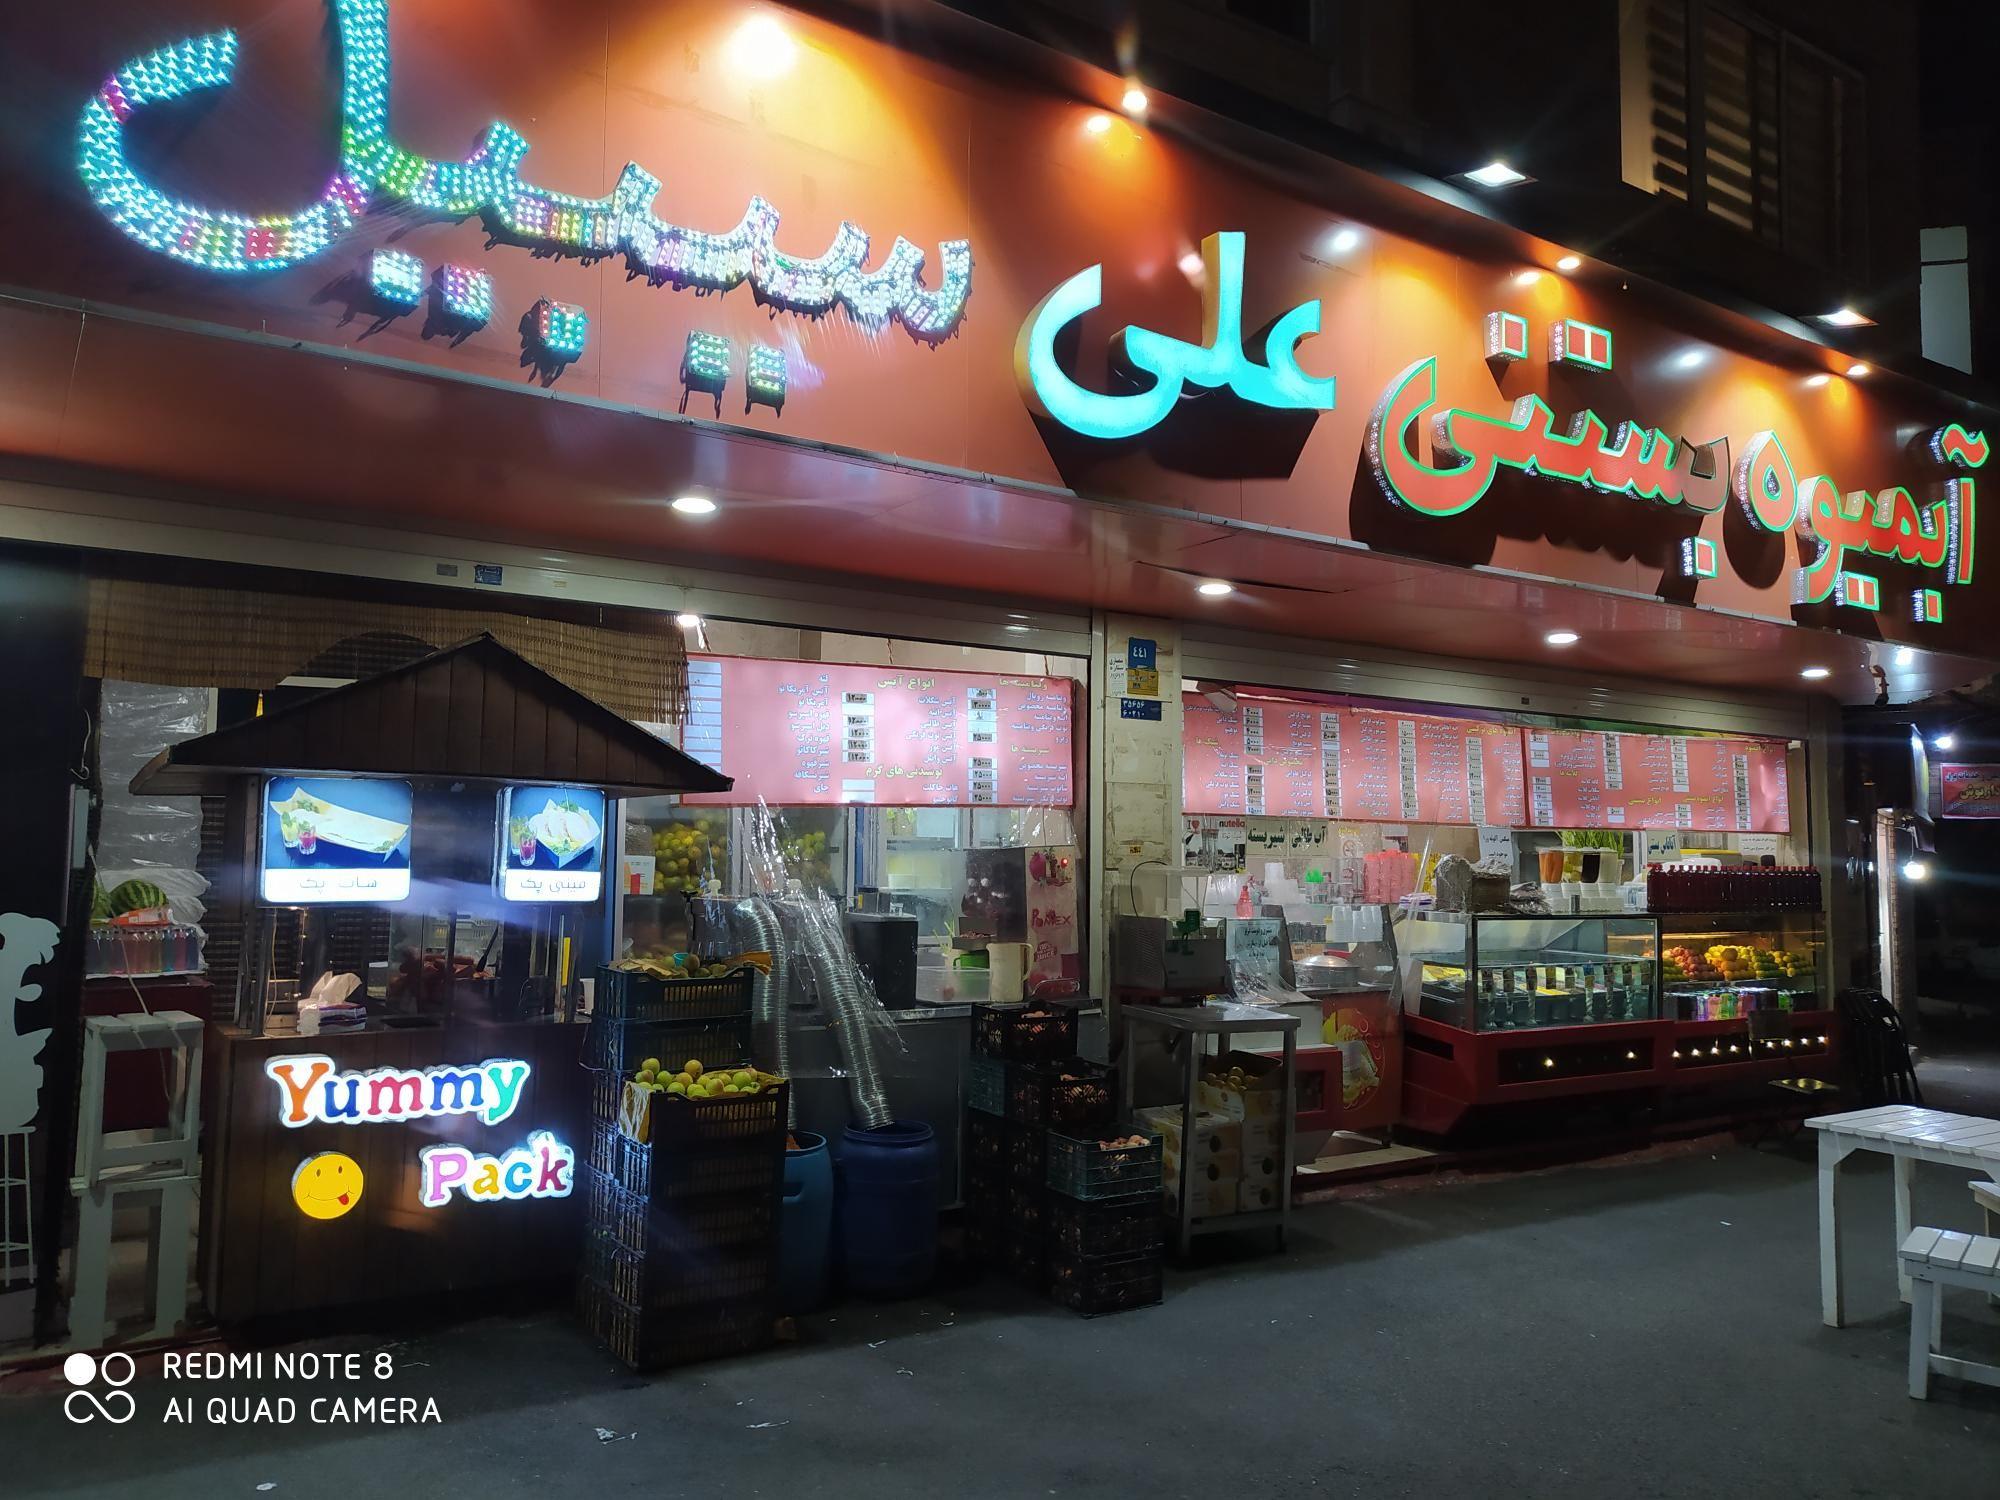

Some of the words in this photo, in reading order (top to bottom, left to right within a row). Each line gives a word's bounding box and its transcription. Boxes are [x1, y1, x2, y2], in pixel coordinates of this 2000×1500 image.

[78, 0, 973, 402] سیبیل
[1015, 230, 1337, 440] علی
[1364, 310, 1731, 580] بستنی
[1734, 424, 1991, 624] آبمیوه
[877, 674, 904, 689] آیس
[906, 677, 936, 691] انواع
[866, 765, 884, 778] گرم
[885, 765, 904, 778] های
[905, 767, 943, 779] نوشیدنی
[1219, 819, 1245, 828] nutella
[1247, 828, 1268, 849] پسته
[1269, 825, 1285, 849] شیر
[1314, 825, 1327, 848] آب
[520, 878, 543, 894] پک
[549, 879, 586, 894] مینی
[269, 1059, 528, 1125] Yummy
[427, 1145, 570, 1203] Pack
